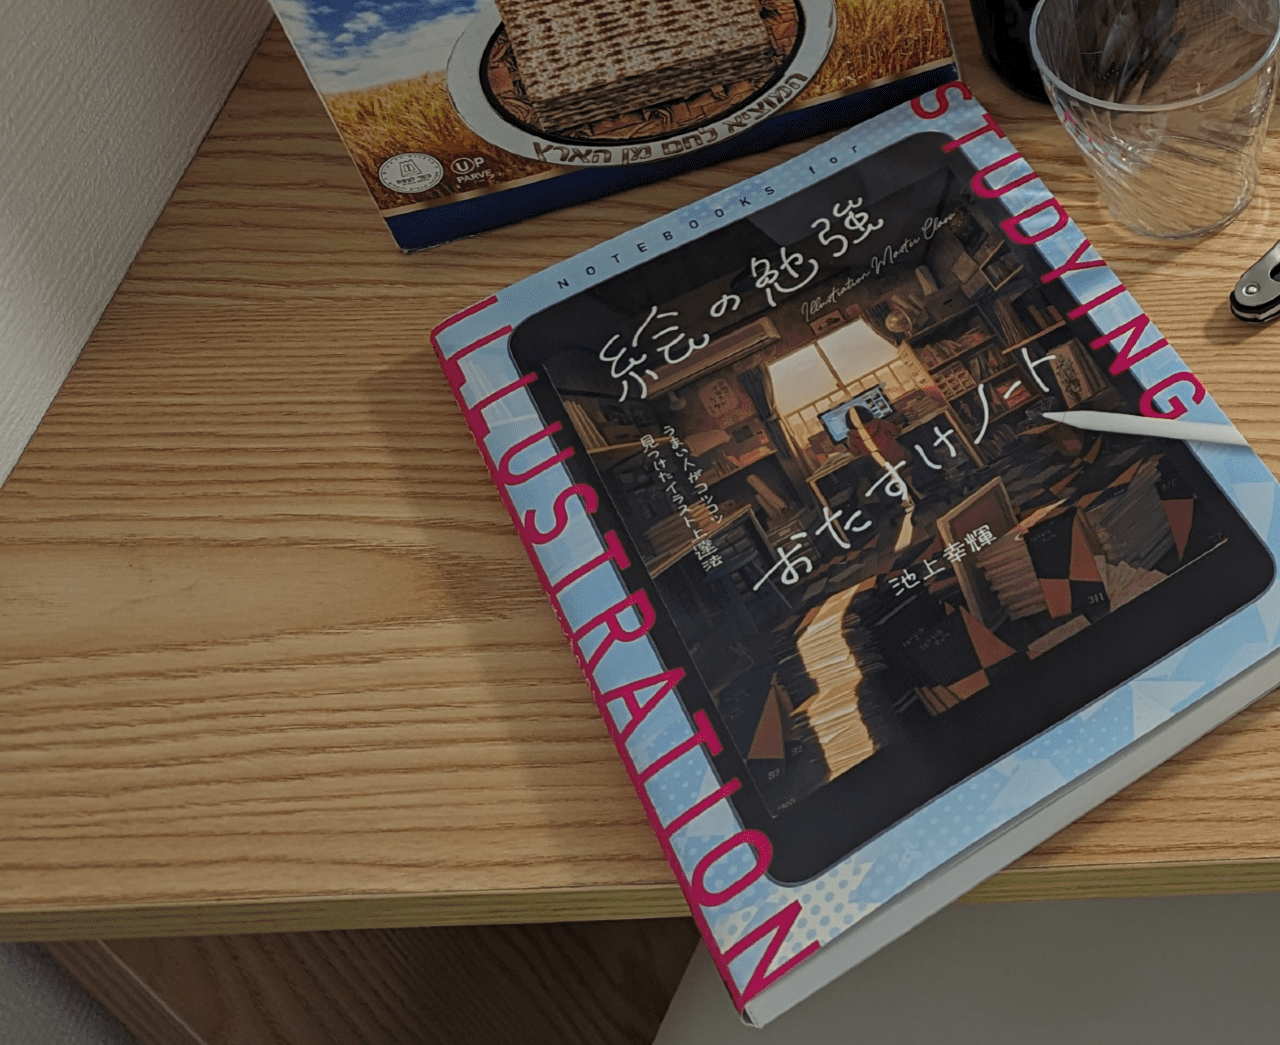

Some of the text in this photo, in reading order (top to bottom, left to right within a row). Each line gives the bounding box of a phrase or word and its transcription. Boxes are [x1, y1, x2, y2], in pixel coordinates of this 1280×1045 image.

[456, 169, 492, 184] PARVE
[556, 146, 860, 291] NOTEBOOKS for
[598, 196, 885, 403] 絵の勉強
[801, 271, 871, 323] Illustration
[871, 237, 921, 275] Master
[910, 80, 1206, 421] STUDYING
[640, 434, 724, 573] 見つけたイラスト上達法
[663, 425, 723, 524] うまい人がコツコツ
[752, 347, 1056, 592] おたすけノート
[888, 522, 998, 598] 池上幸輝
[431, 294, 823, 1013] ILLUSTRATION
